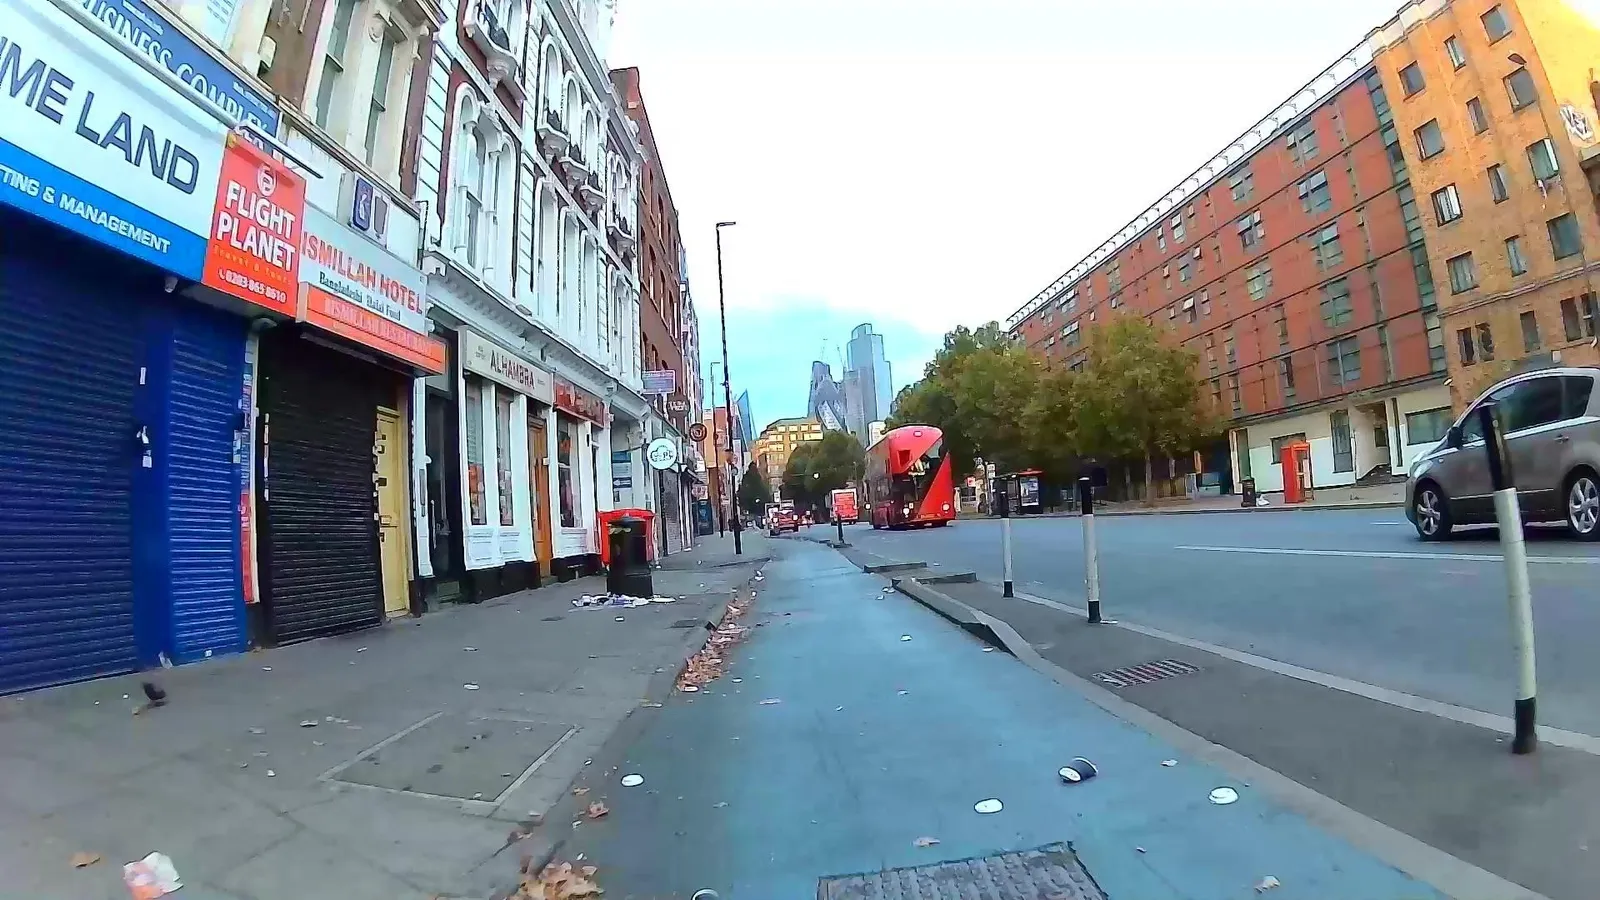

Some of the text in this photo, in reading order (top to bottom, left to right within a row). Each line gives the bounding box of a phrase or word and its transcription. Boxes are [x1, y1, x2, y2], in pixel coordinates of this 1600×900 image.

[83, 0, 174, 71] USINESS
[0, 36, 200, 195] ME LAND
[42, 185, 57, 204] &
[59, 192, 171, 254] MANAGEMENT
[225, 179, 296, 239] FLIGHT
[215, 211, 296, 272] PLANET
[380, 273, 423, 315] HOTEL
[490, 349, 535, 390] ALHAMBRA
